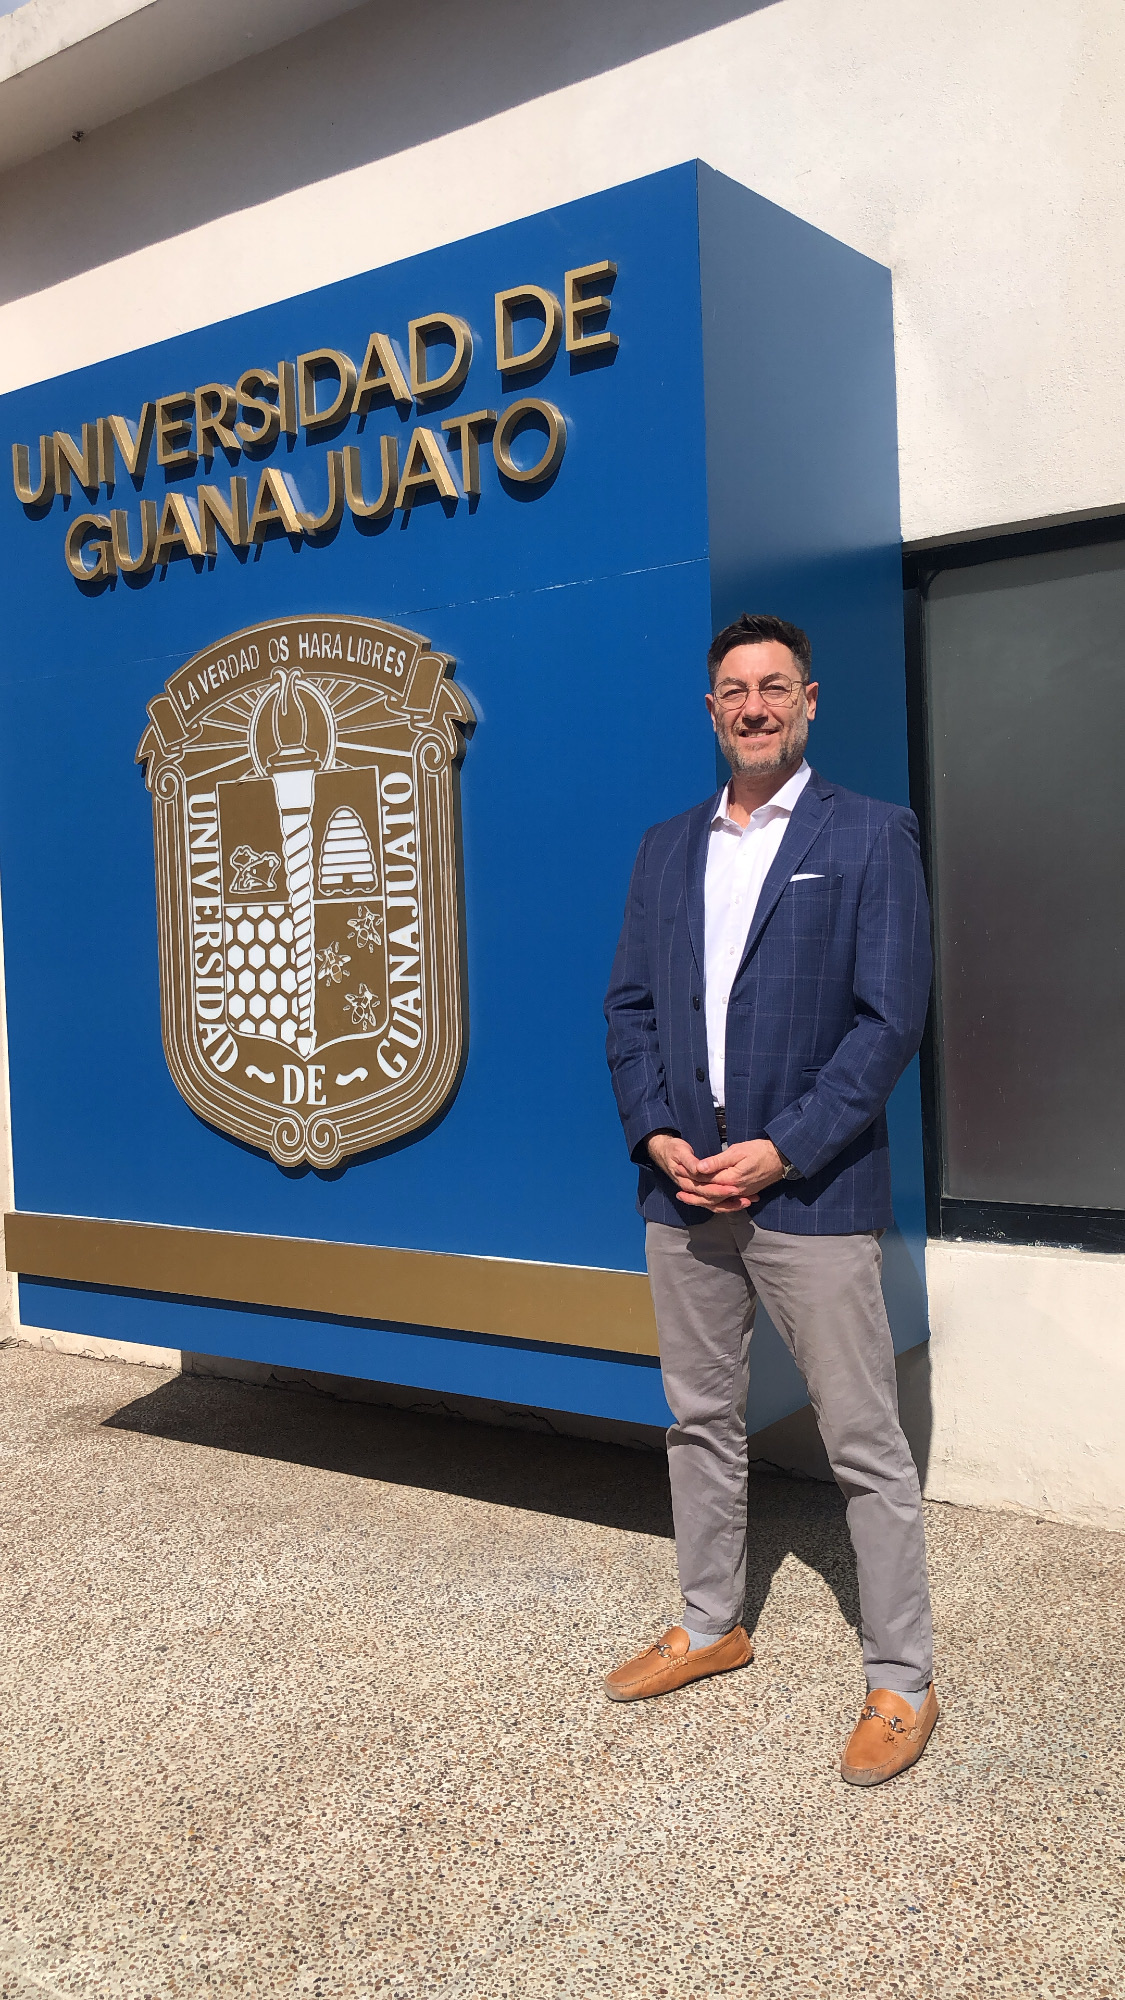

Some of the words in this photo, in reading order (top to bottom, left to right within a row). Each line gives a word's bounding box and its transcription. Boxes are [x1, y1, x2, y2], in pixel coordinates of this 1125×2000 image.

[12, 312, 473, 504] UNIVERSIDAD
[495, 260, 619, 376] DE
[65, 398, 567, 582] GUANAJUATO
[178, 680, 200, 711] LA
[197, 645, 260, 693] VERDAD
[268, 635, 290, 663] OS
[346, 636, 407, 678] LIBRES
[187, 791, 239, 1073] UNIVERSIDAD
[282, 1064, 327, 1105] DE
[376, 771, 422, 1079] GUANAJUATO
